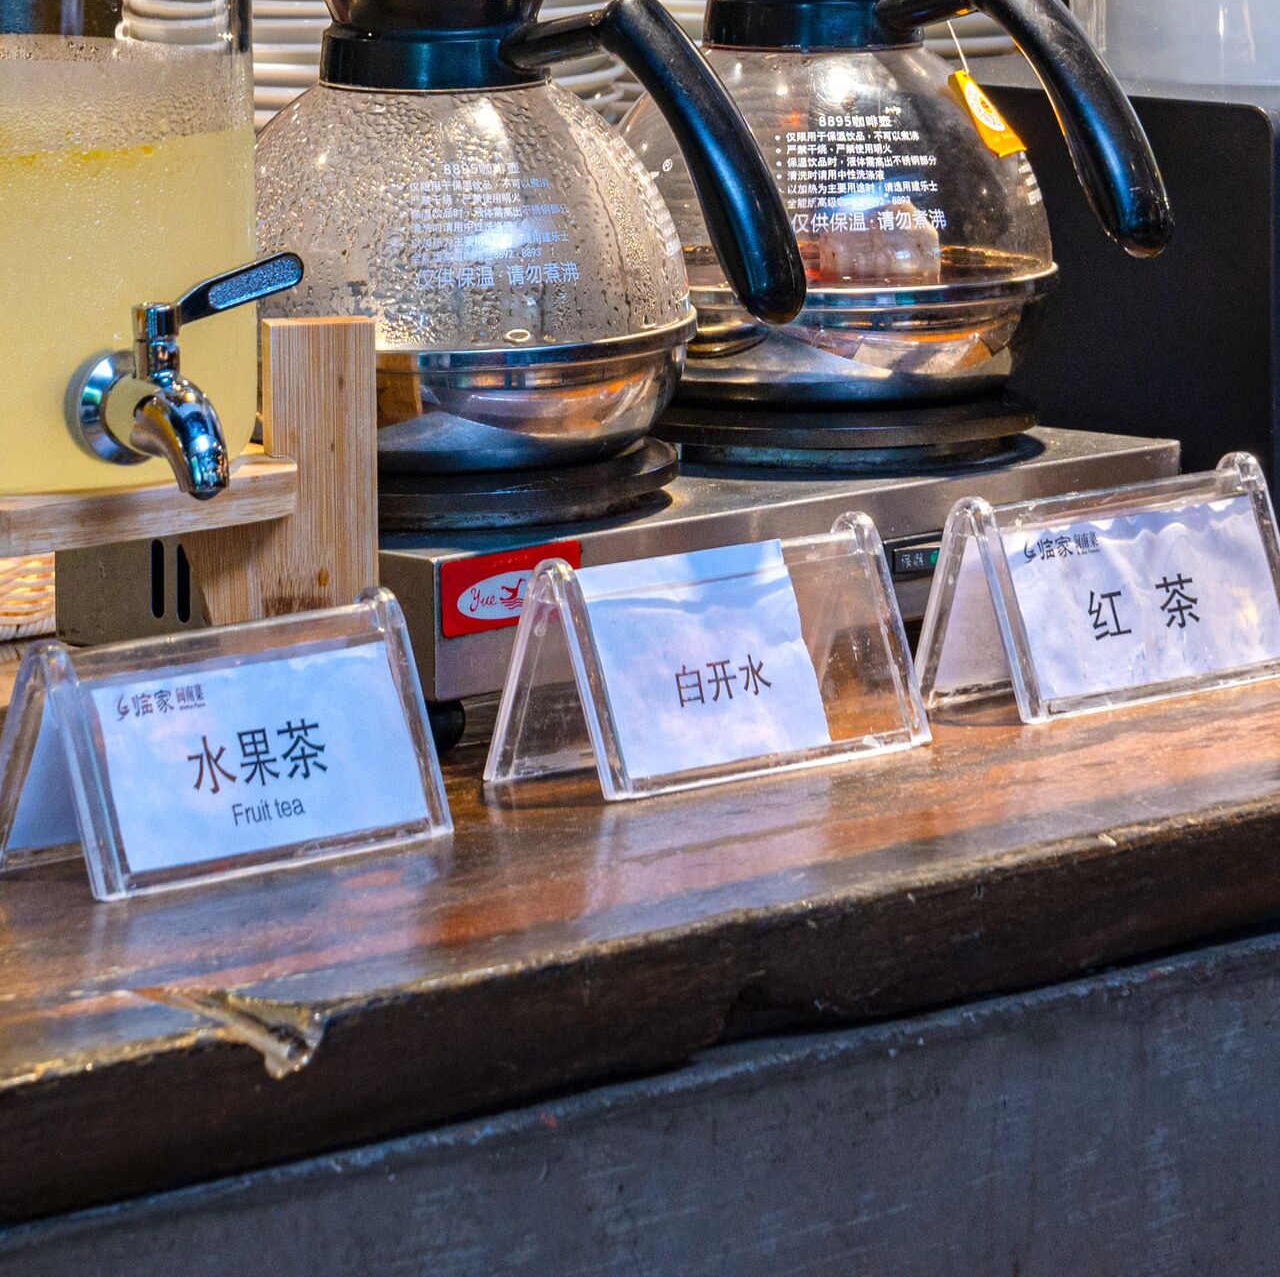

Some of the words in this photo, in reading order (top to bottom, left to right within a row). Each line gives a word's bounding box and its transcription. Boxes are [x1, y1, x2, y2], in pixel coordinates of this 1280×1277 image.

[675, 654, 772, 708] 白开水
[187, 718, 328, 794] 水果茶
[232, 799, 273, 826] Fruit
[276, 795, 306, 819] tea
